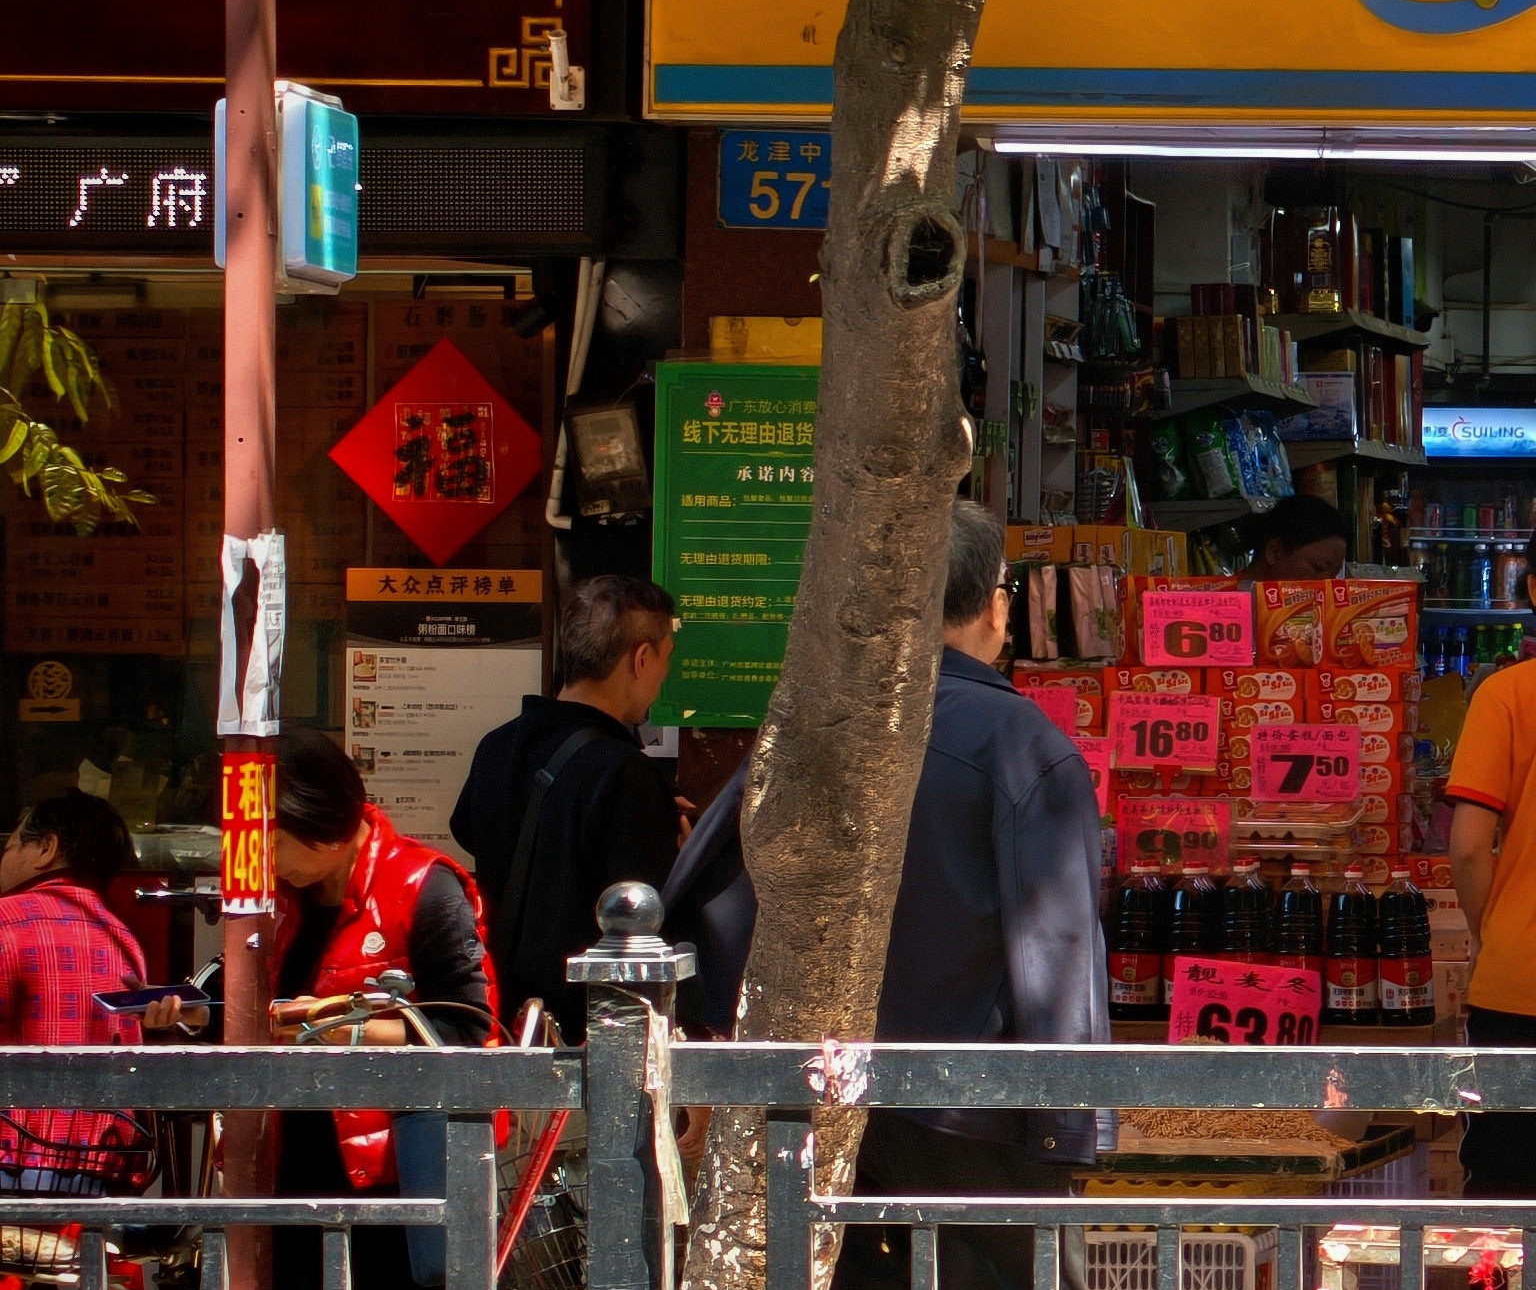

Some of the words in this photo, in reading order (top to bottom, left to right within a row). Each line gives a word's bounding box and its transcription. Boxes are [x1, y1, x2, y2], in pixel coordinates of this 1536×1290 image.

[750, 171, 831, 219] 57
[682, 419, 814, 446] 线下无理由退货
[1461, 426, 1525, 439] SUILING
[737, 465, 815, 483] 承诺内容
[378, 575, 517, 596] 大众点评榜单
